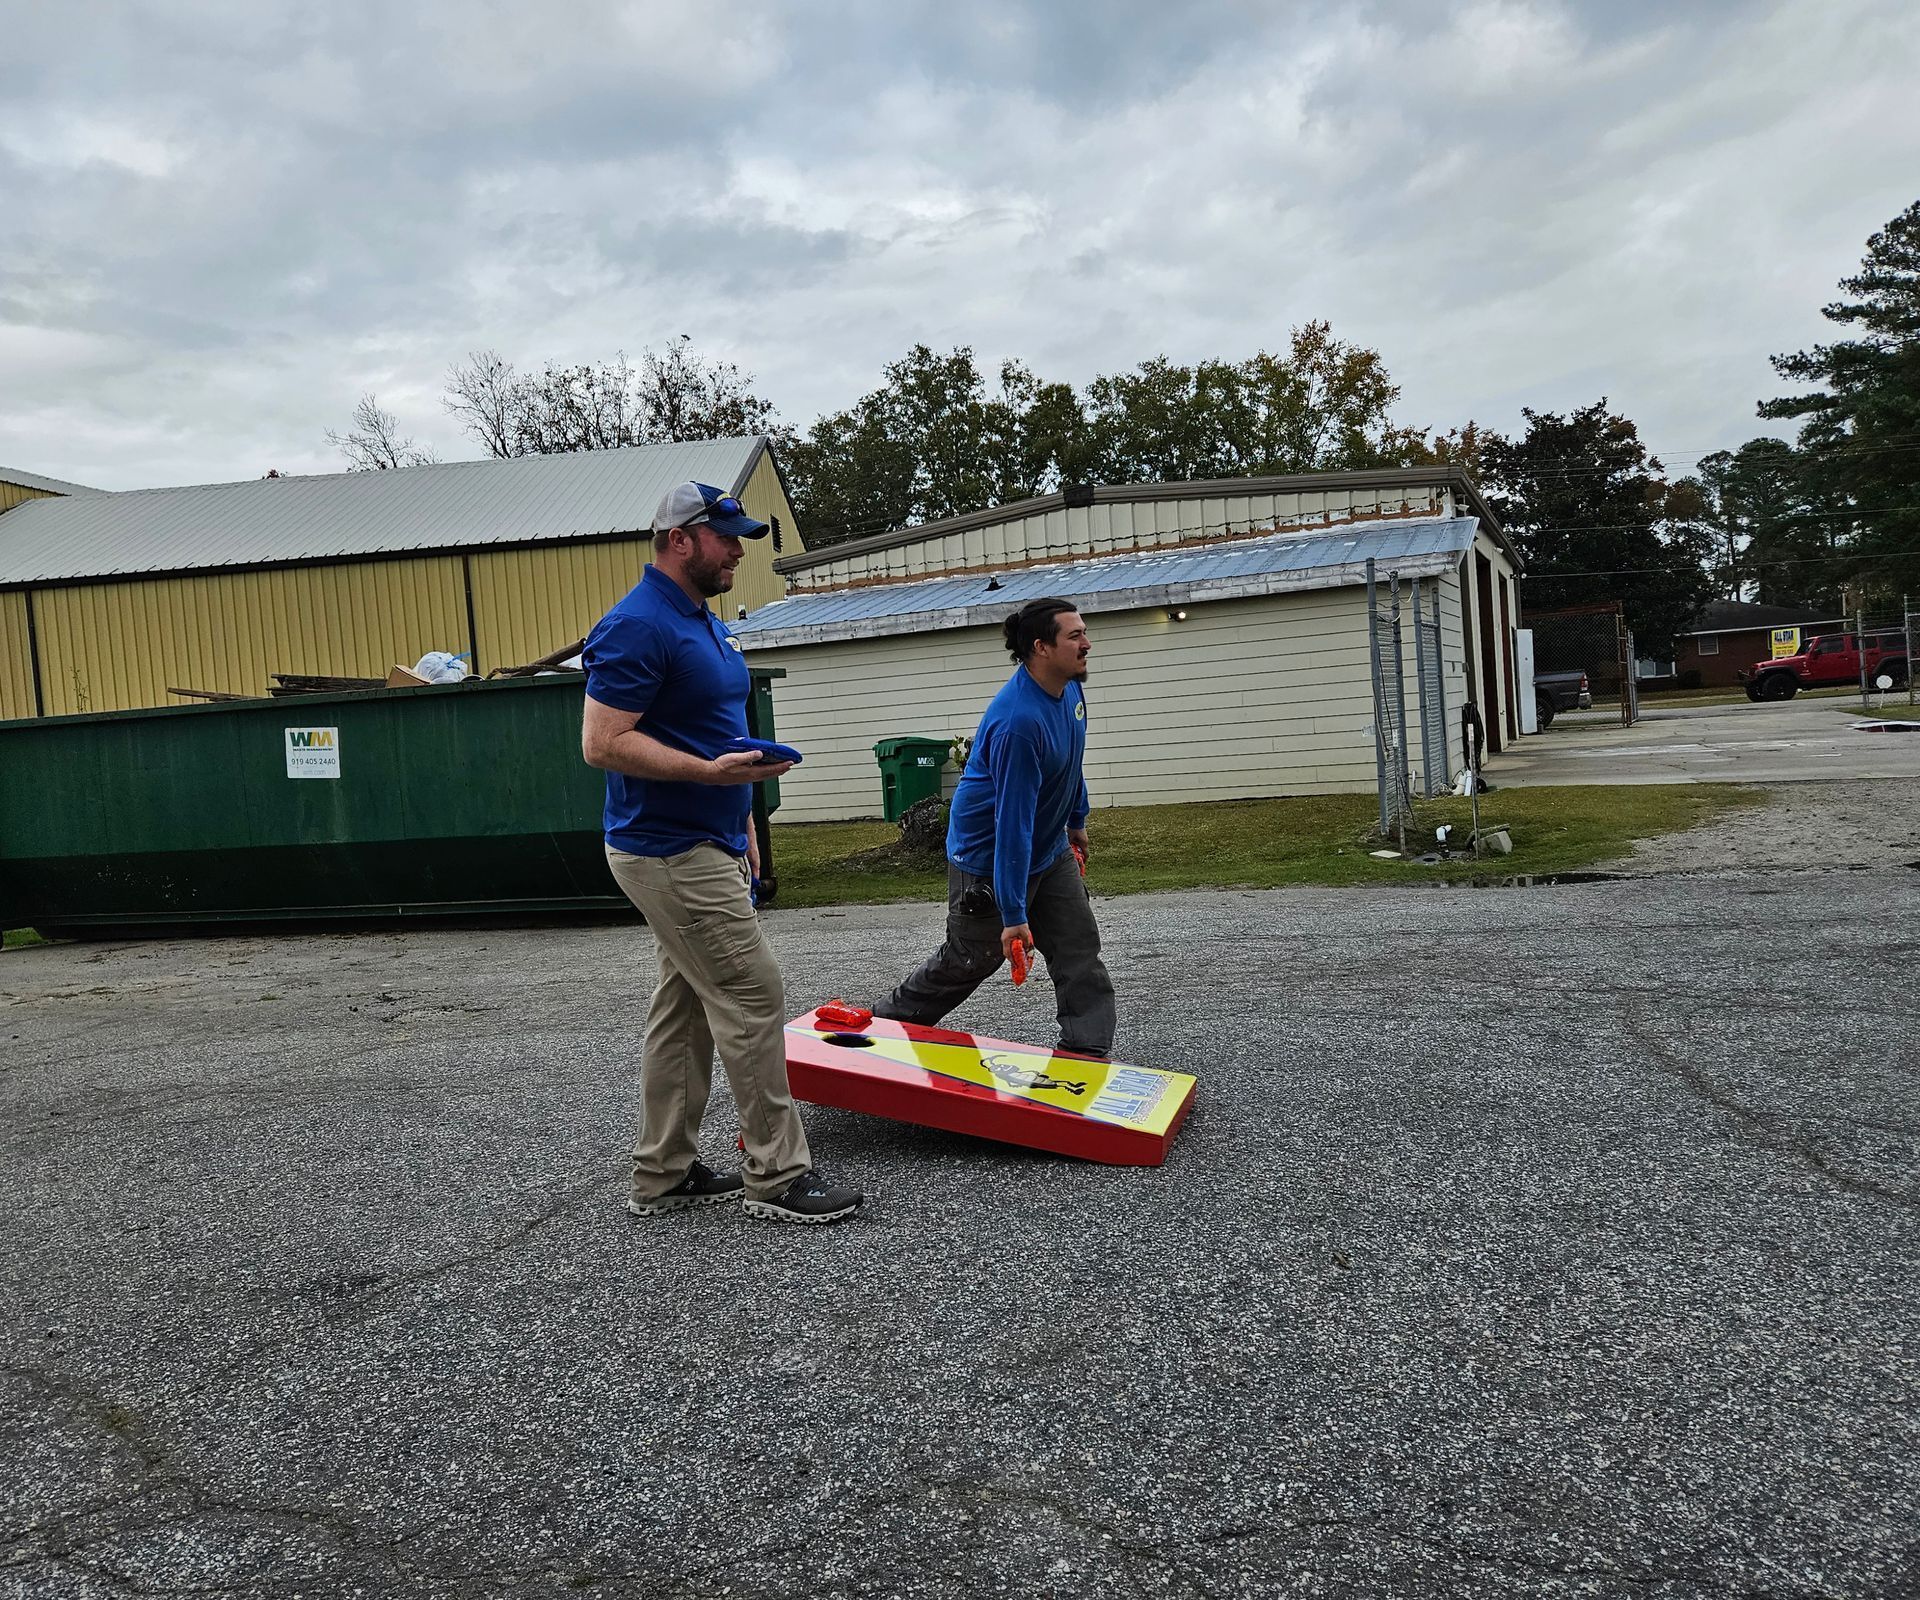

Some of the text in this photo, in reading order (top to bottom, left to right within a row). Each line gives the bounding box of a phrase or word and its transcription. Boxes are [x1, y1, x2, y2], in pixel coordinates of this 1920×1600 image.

[290, 731, 333, 746] WM
[291, 758, 304, 766] 919
[319, 757, 336, 766] 2440
[917, 757, 935, 765] WM
[1105, 1069, 1163, 1097] STAR
[1090, 1096, 1143, 1119] ALL
